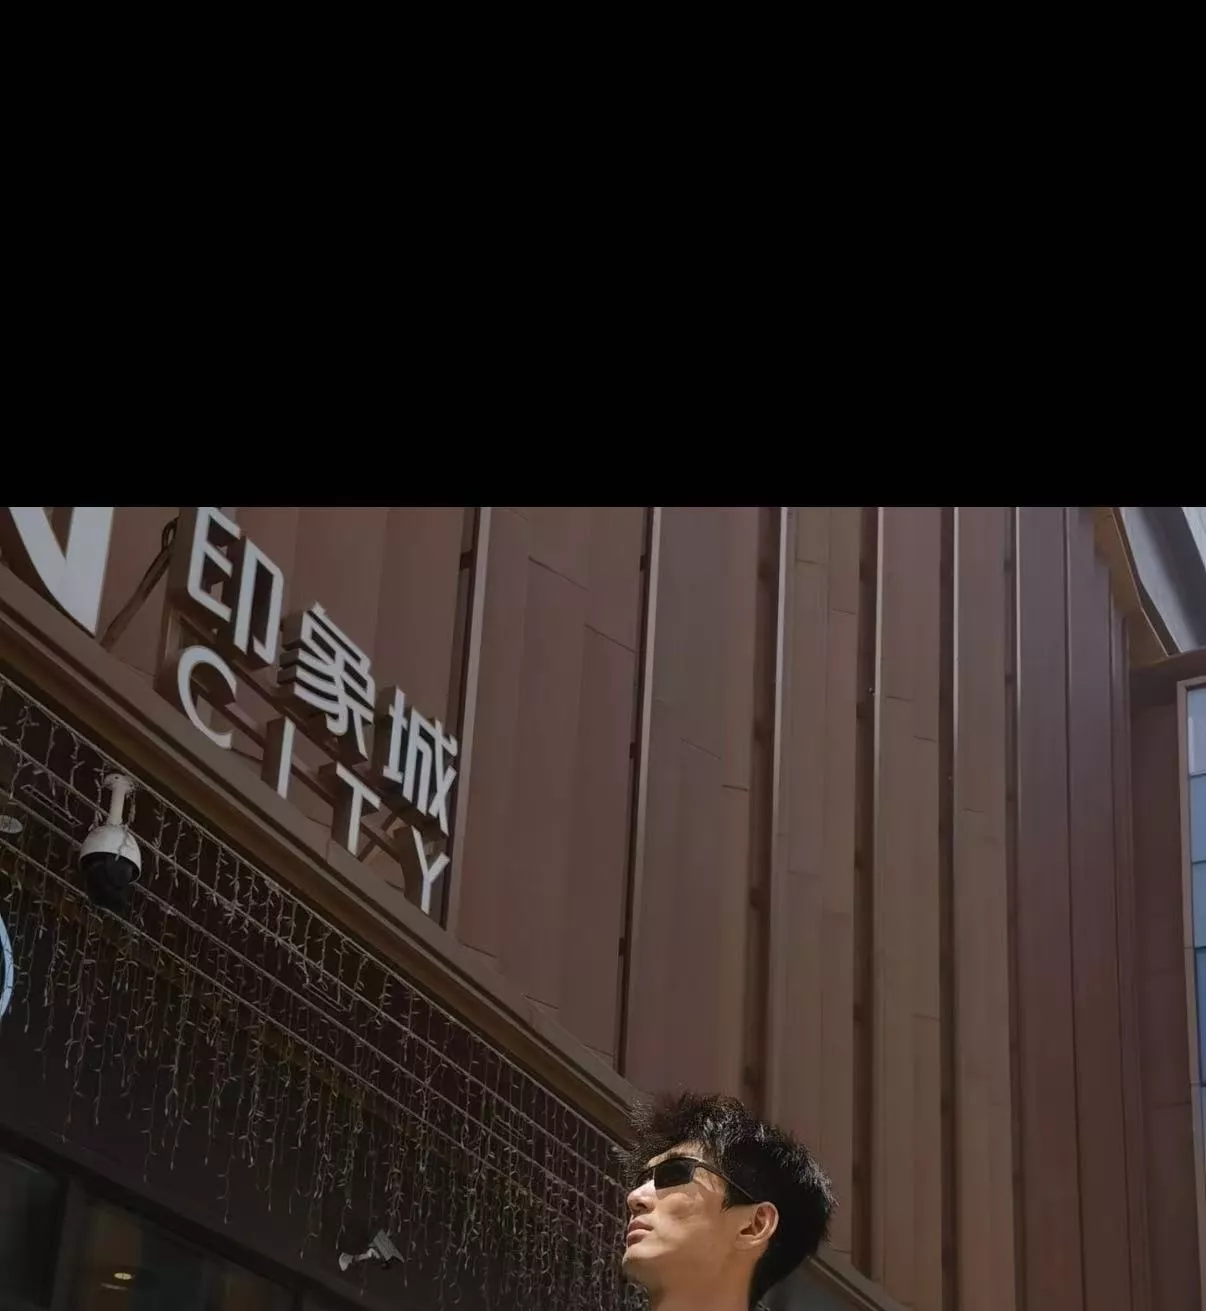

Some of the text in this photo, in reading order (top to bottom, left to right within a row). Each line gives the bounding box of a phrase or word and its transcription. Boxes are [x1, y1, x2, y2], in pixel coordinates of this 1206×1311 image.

[177, 645, 450, 915] CITY
[187, 507, 458, 835] 印象城
